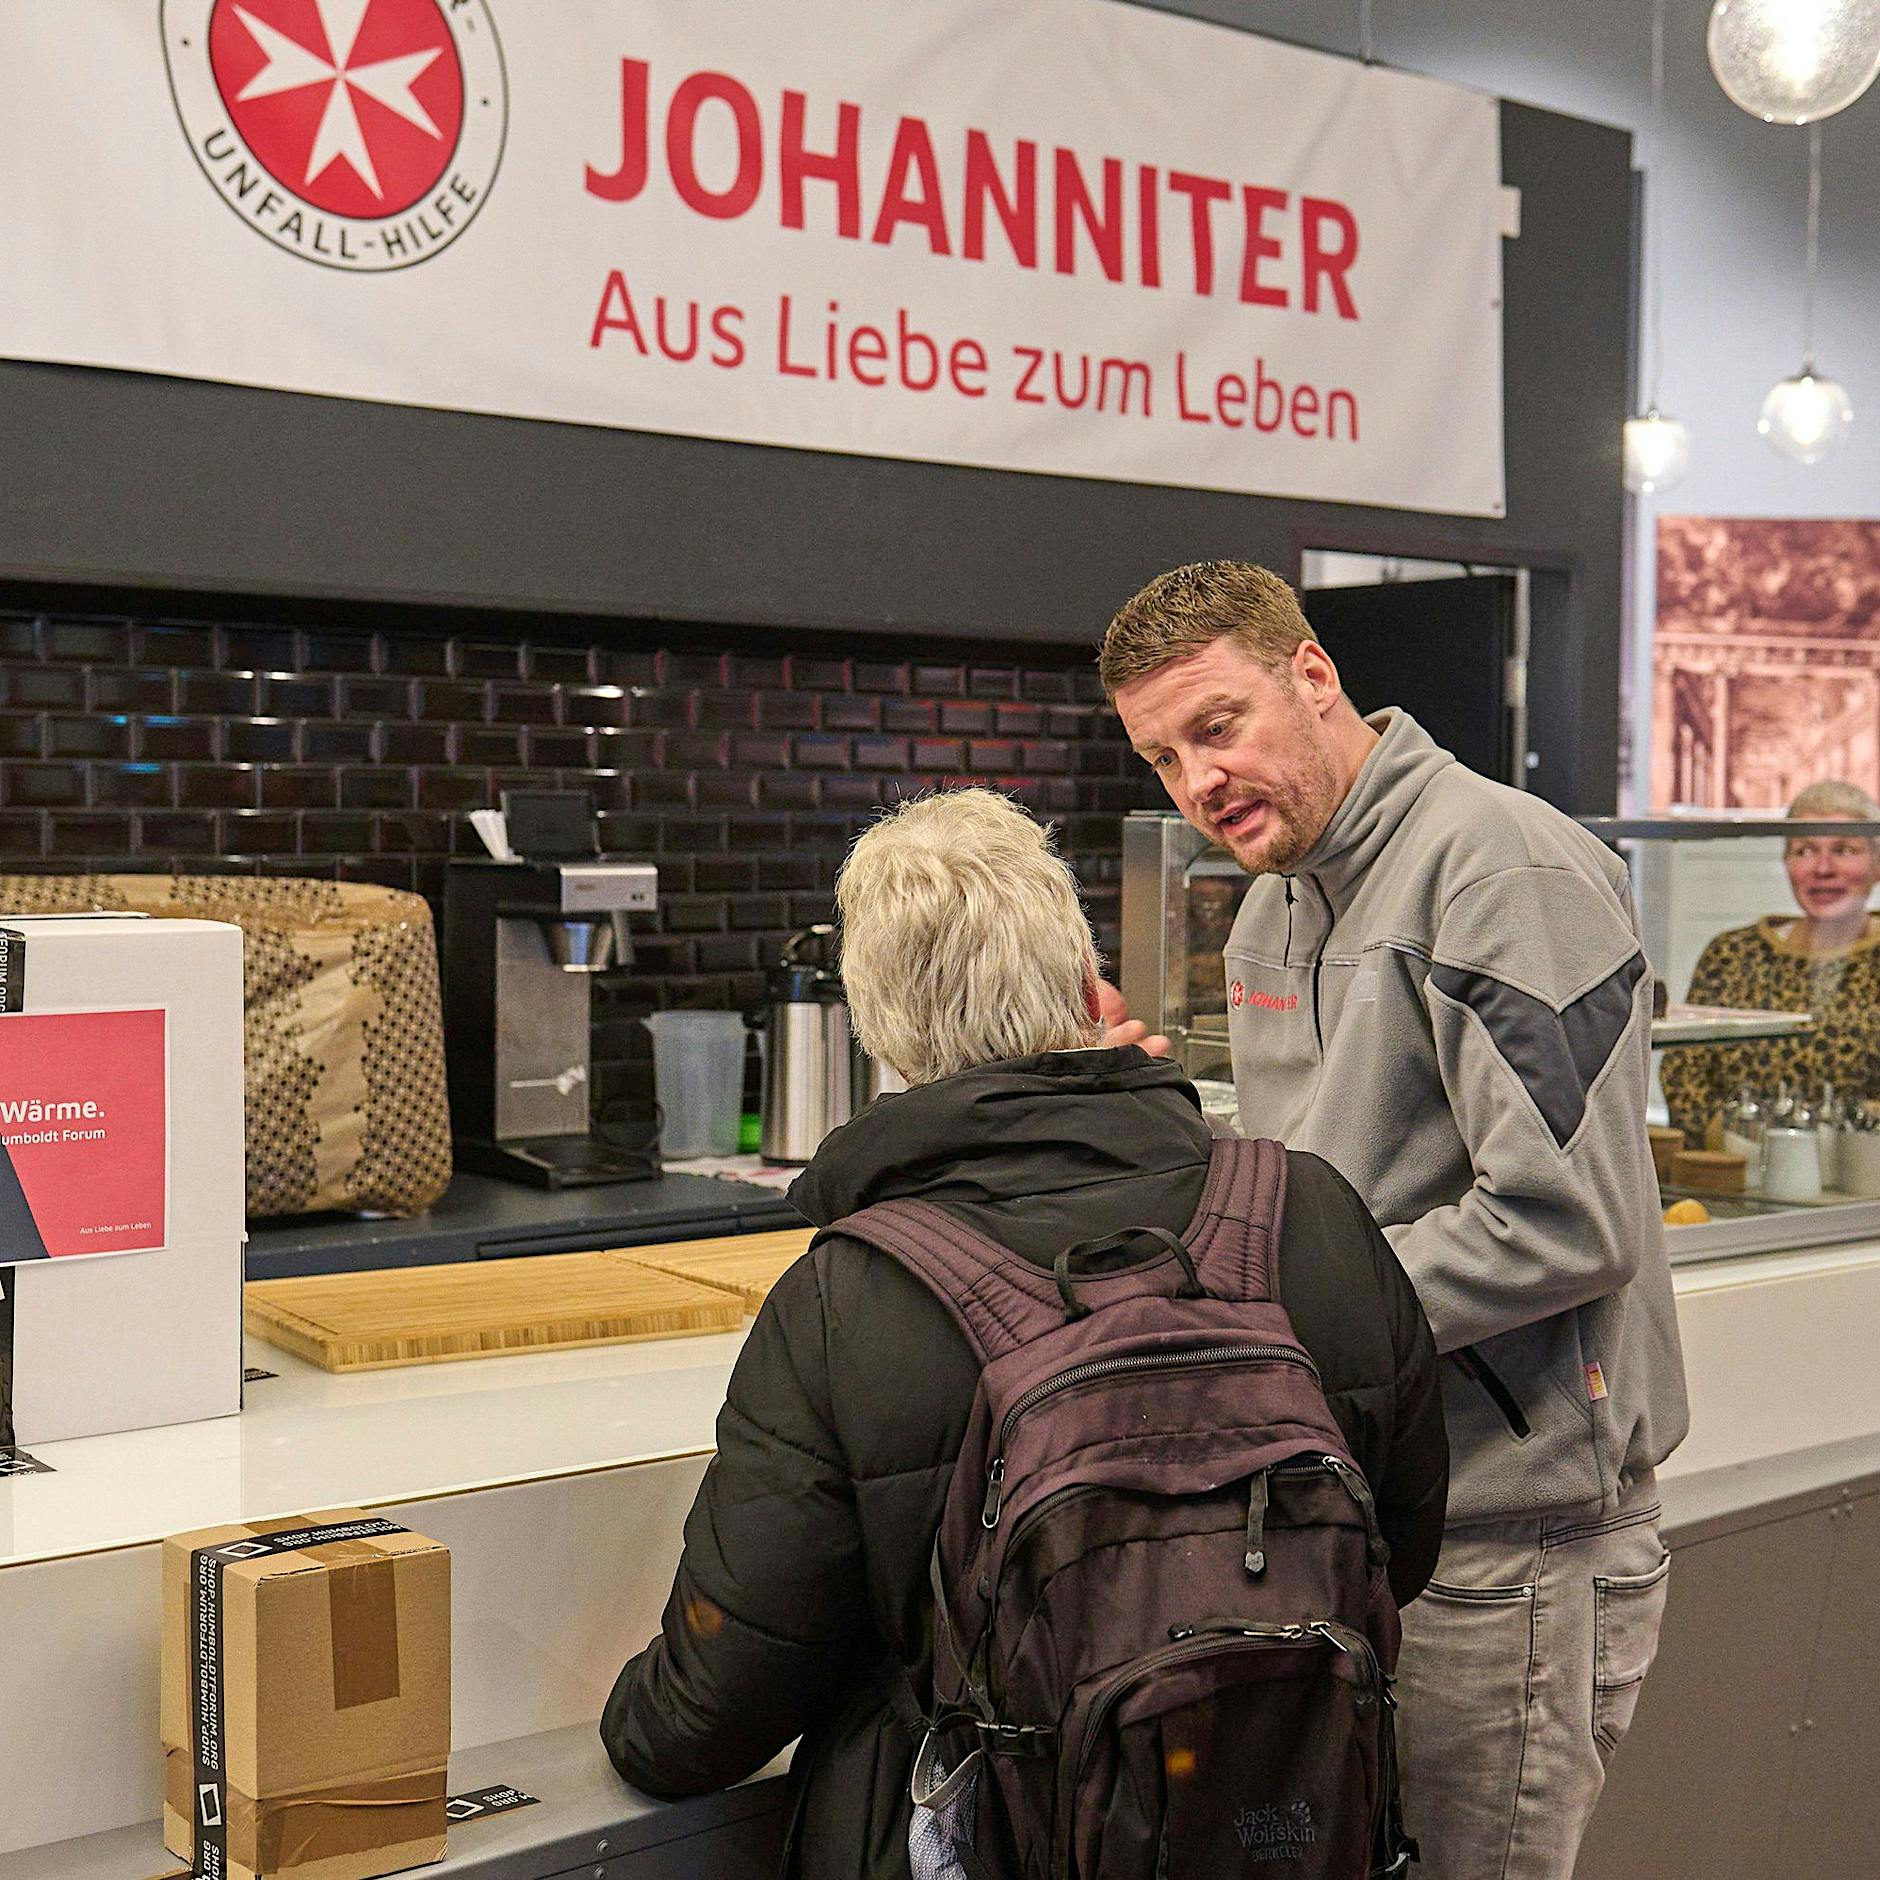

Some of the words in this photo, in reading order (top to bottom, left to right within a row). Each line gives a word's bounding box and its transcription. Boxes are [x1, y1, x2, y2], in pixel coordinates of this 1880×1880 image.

[204, 129, 478, 261] UNFALL-HILFE
[585, 57, 1359, 320] JOHANNITER
[590, 269, 745, 369] Aus
[778, 295, 988, 398] Liebe
[1013, 347, 1152, 417] zum
[1176, 351, 1358, 441] Leben
[0, 1099, 106, 1124] Wärme.
[62, 1128, 106, 1142] Forum
[79, 1226, 93, 1235] Aus
[94, 1225, 113, 1233] Liebe
[130, 1222, 152, 1230] Leben
[199, 1554, 210, 1767] SHOP.HUMBOLDTFORUM.ORG
[207, 1557, 219, 1770] SHOP.HUMBOLDTFORUM.ORG
[1233, 1803, 1280, 1827] Jack
[1236, 1820, 1316, 1848] Wolfskin
